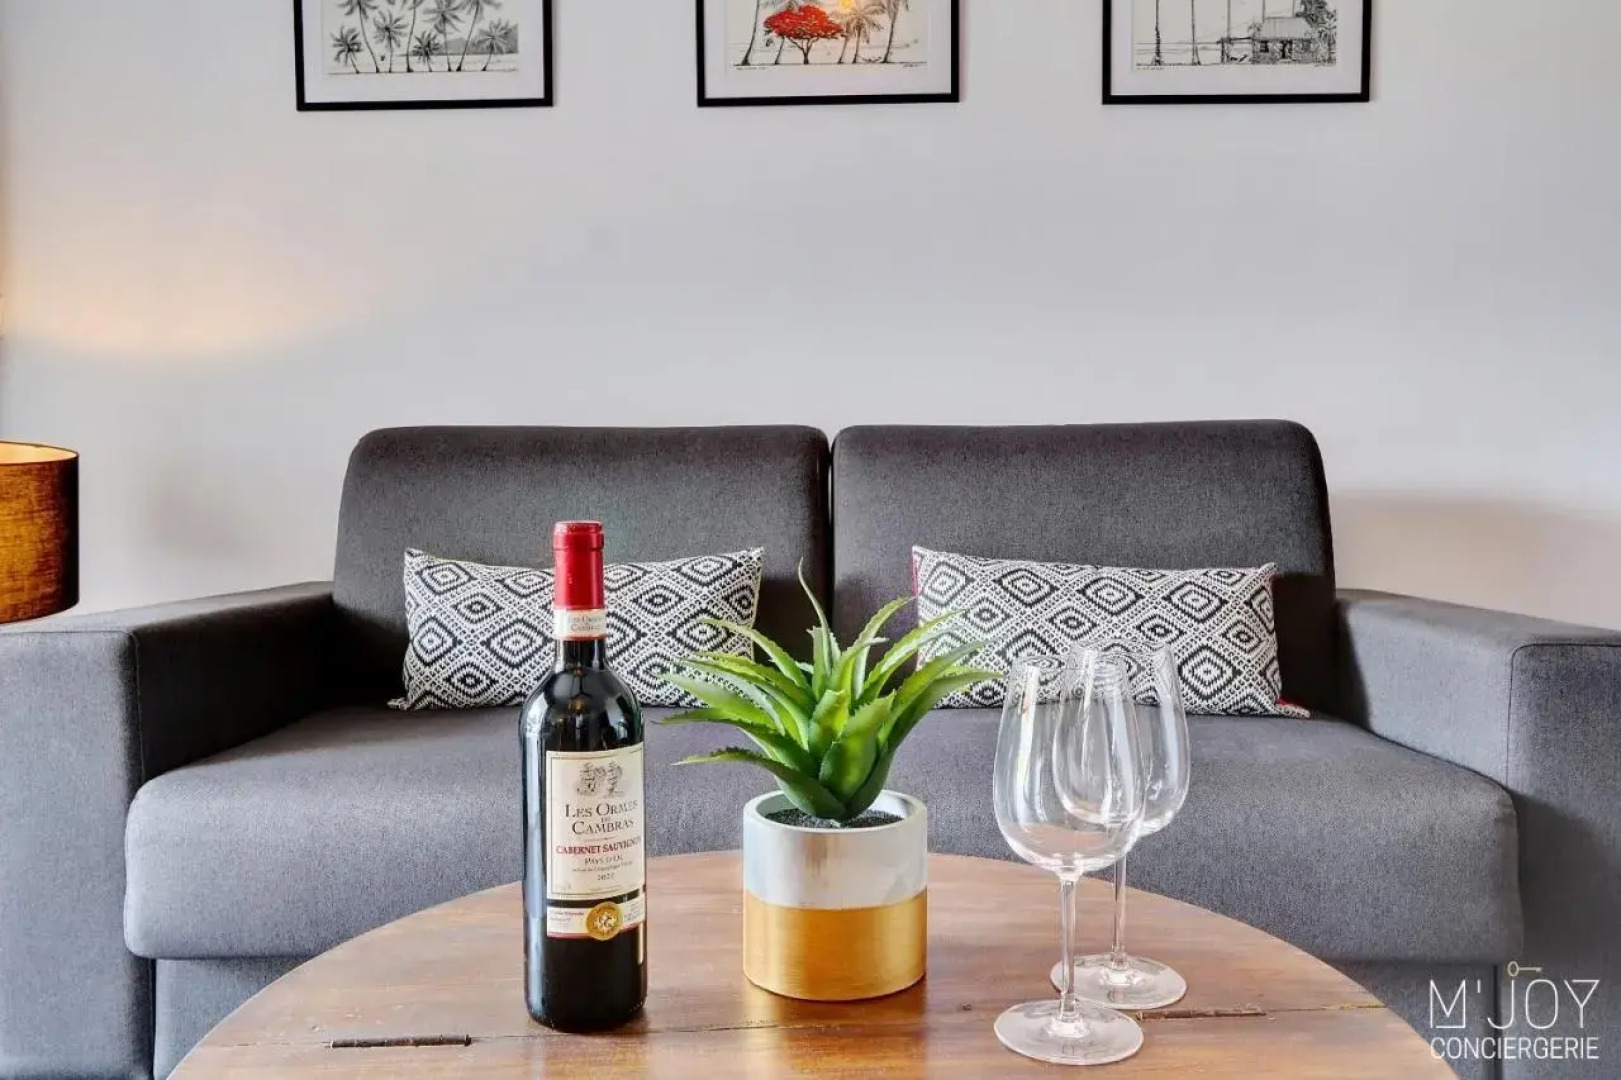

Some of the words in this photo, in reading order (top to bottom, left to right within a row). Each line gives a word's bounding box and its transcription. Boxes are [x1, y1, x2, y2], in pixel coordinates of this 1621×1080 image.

[565, 804, 592, 817] LES
[572, 819, 634, 835] CAMBRAS
[556, 845, 600, 855] CABERNET
